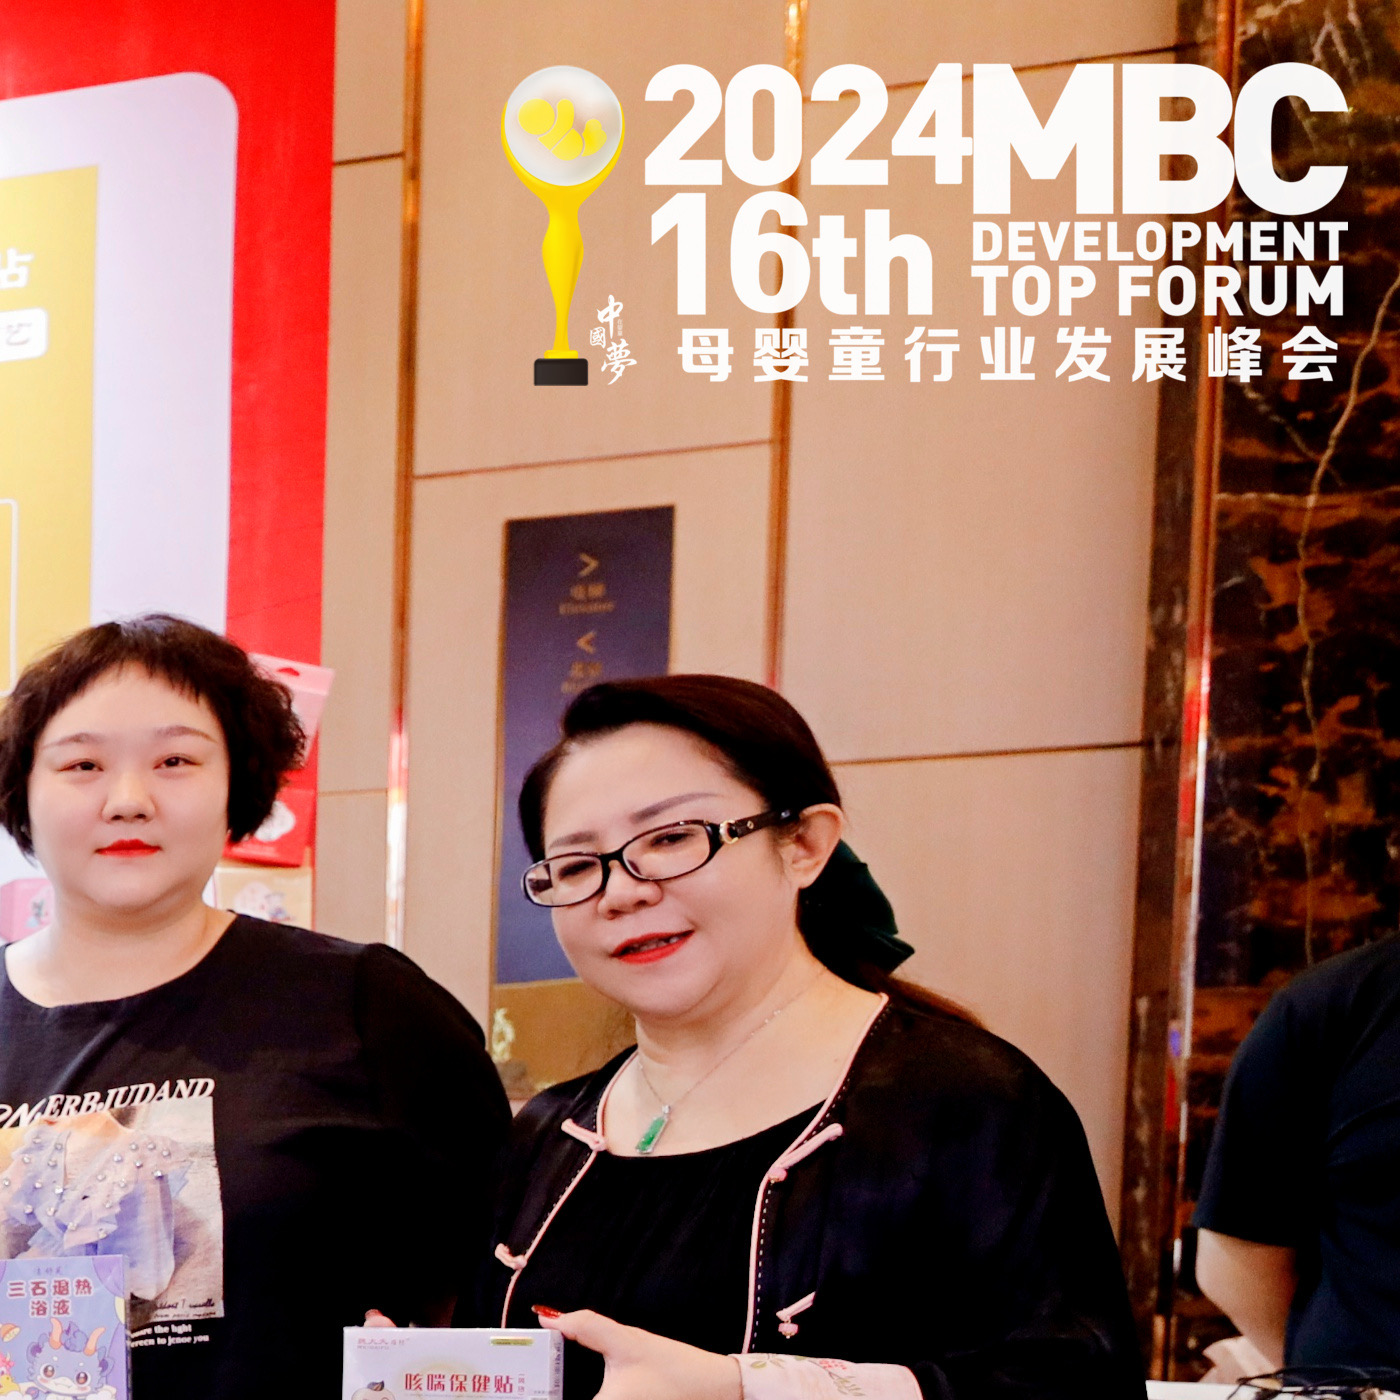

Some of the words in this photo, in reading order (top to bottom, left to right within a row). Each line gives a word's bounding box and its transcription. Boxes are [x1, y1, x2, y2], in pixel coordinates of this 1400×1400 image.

[8, 1278, 92, 1297] 三石退热
[30, 1299, 71, 1316] 浴液
[404, 1372, 514, 1394] 咳喘保健贴
